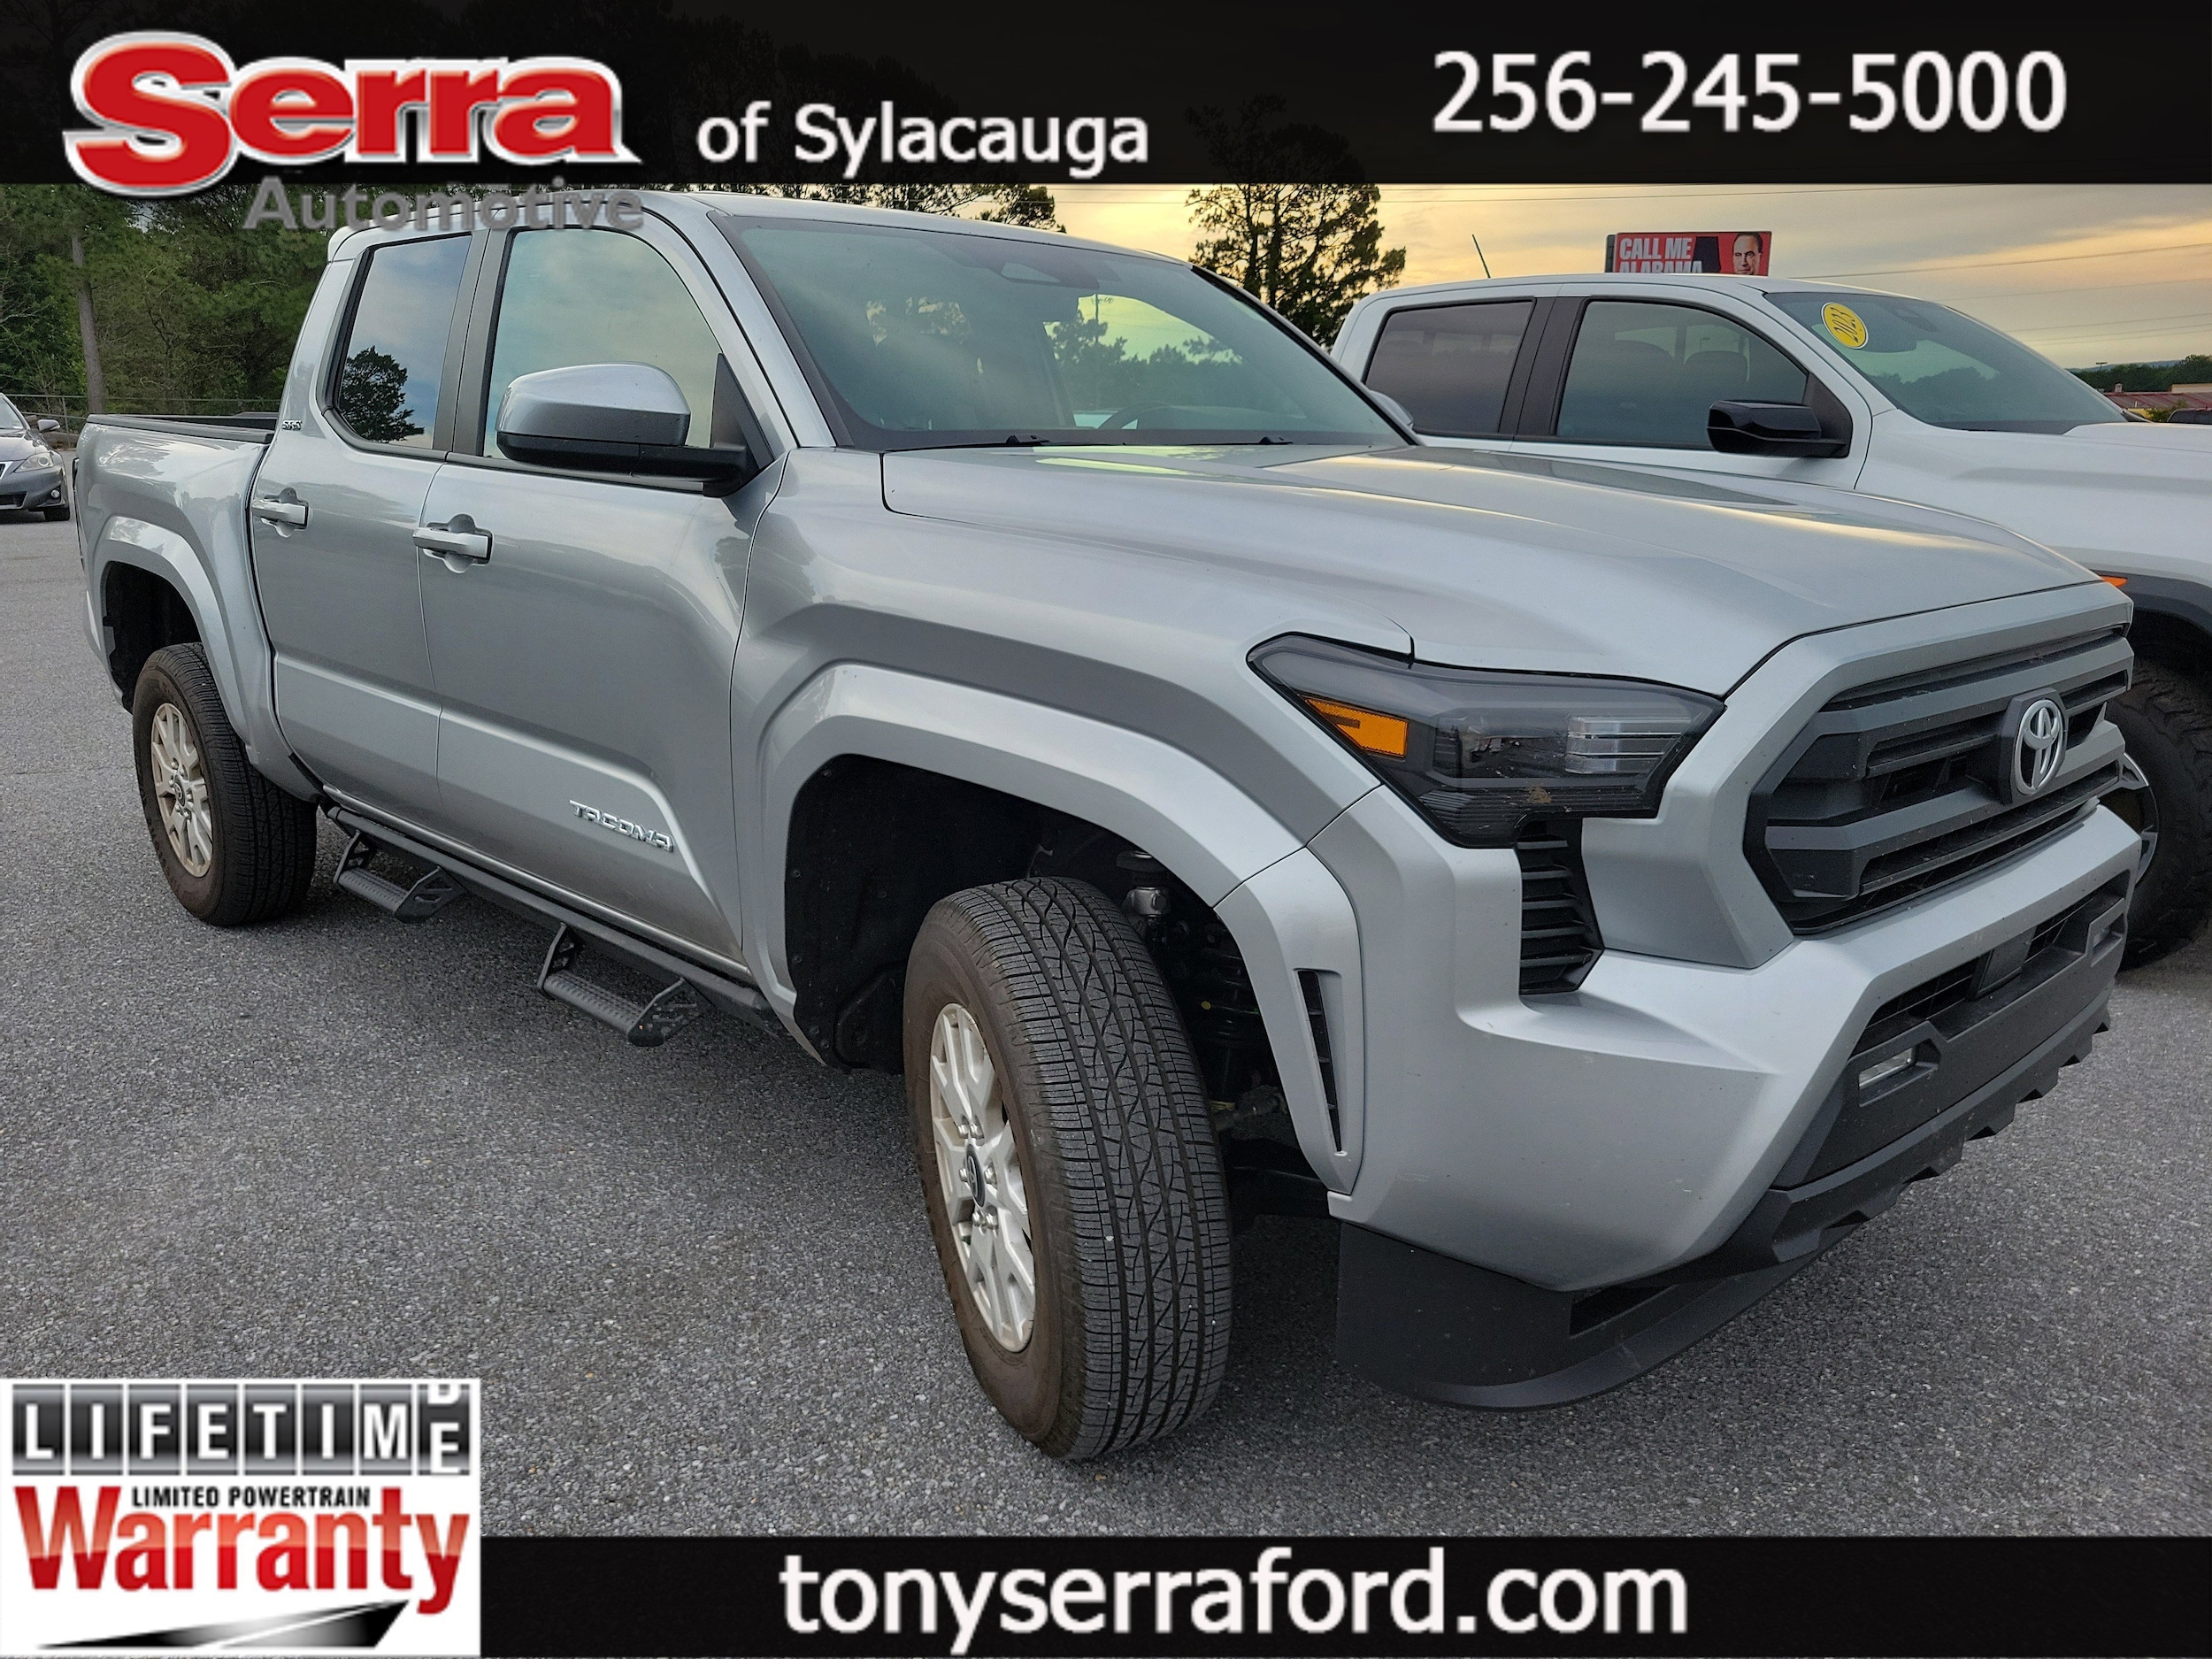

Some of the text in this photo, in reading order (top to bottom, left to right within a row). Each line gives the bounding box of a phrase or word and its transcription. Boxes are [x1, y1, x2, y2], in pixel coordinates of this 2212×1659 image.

[1620, 237, 1693, 260] CALL ME
[569, 799, 674, 853] TACOMA
